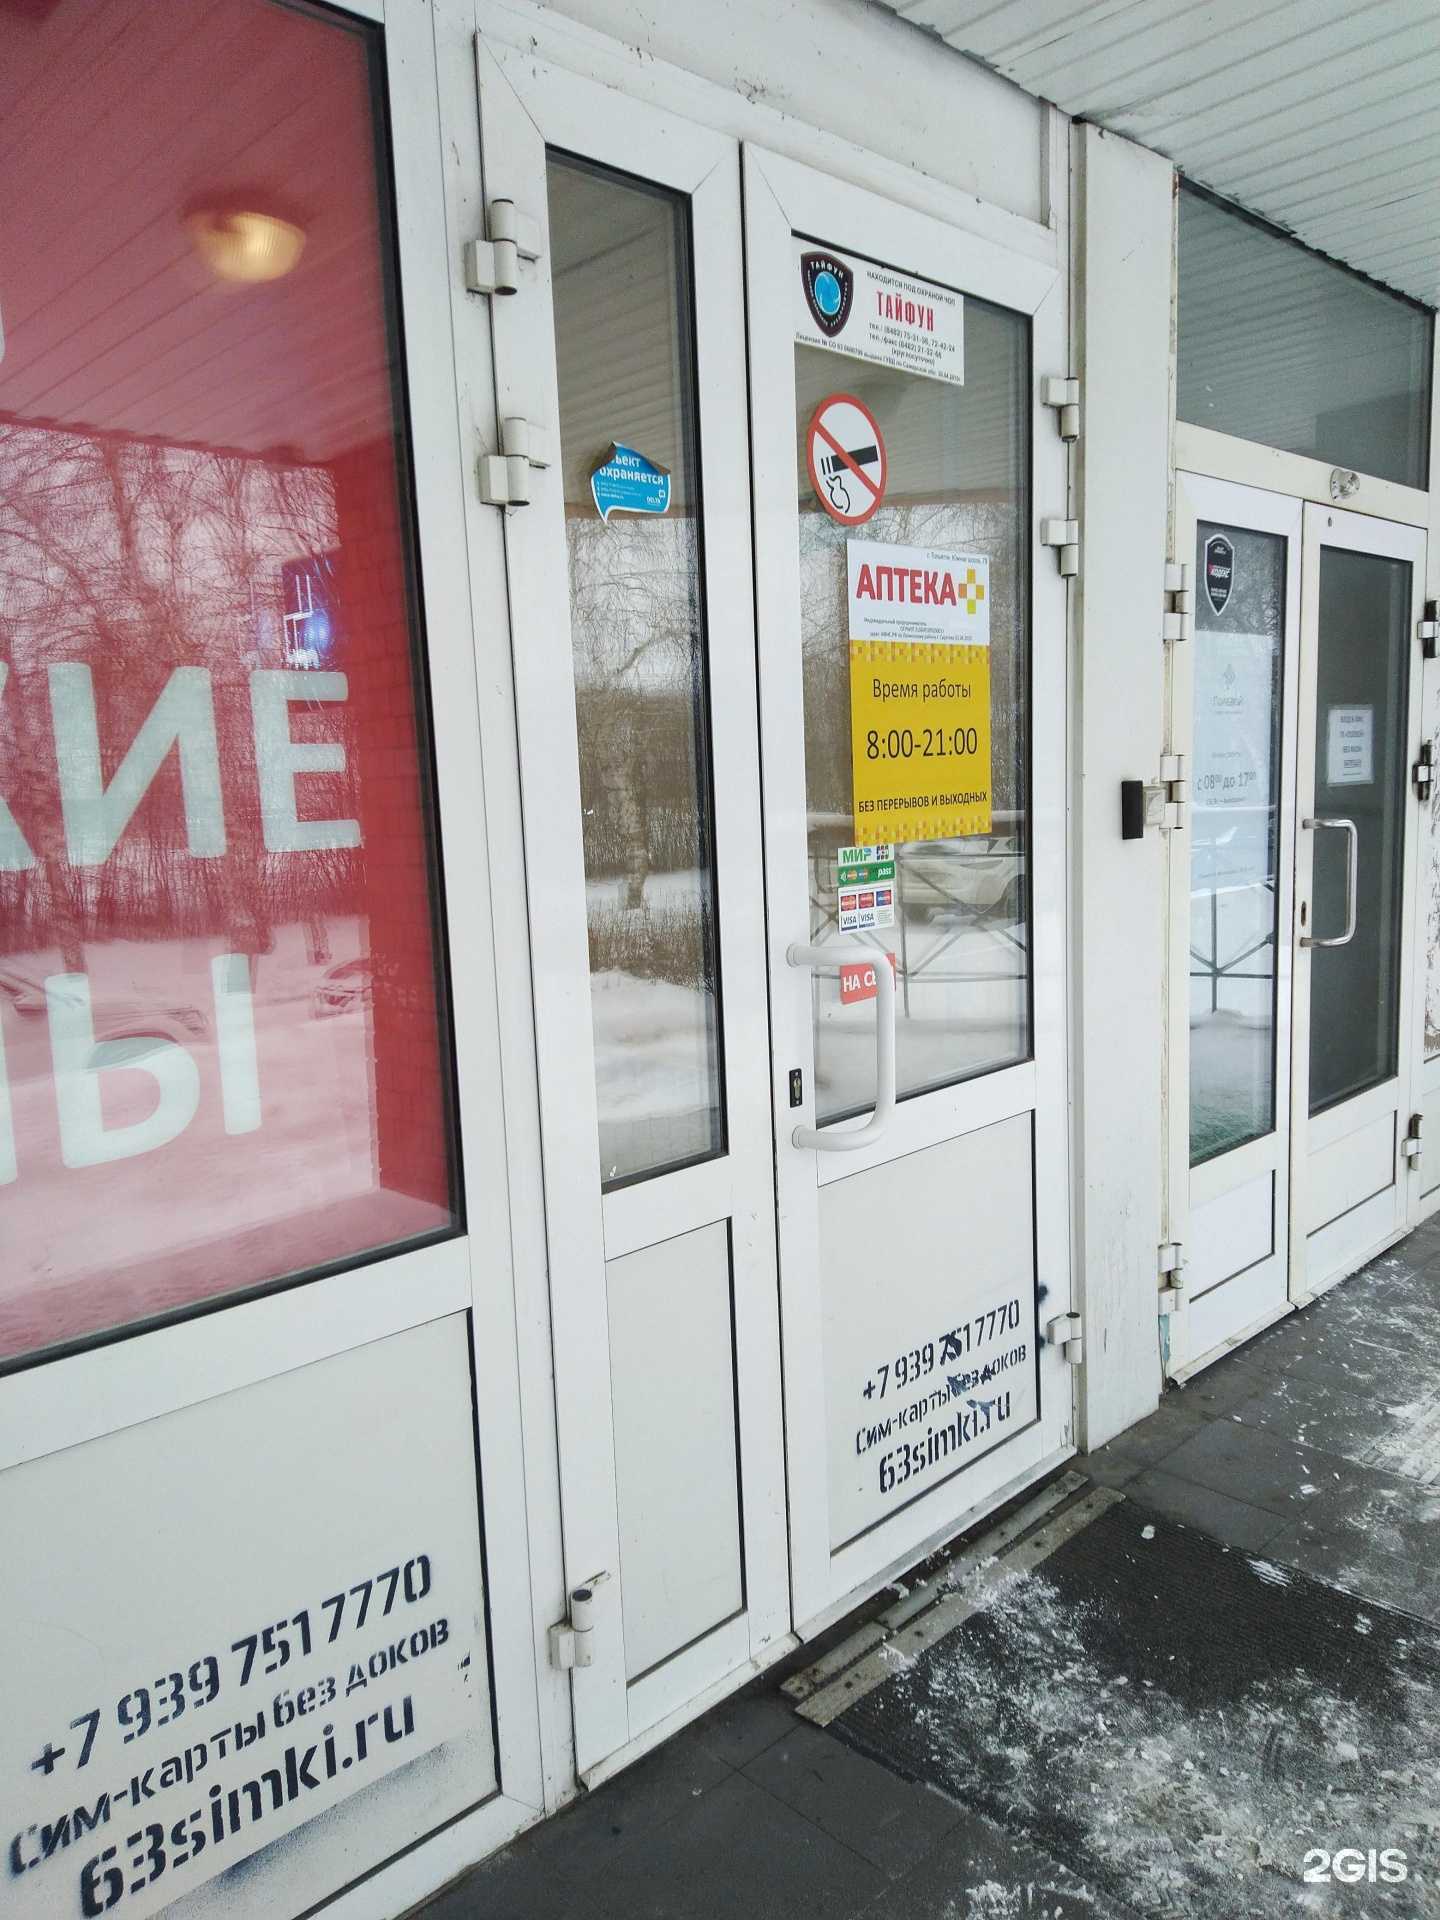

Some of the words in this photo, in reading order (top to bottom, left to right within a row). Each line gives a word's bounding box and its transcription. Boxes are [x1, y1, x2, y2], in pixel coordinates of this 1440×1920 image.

[811, 260, 844, 279] ТАЙФУН
[867, 270, 902, 288] НАХОДИТСЯ
[904, 281, 916, 294] ПОД
[917, 286, 943, 302] ОХРАНОЙ
[876, 291, 935, 332] ТАЙФУН
[599, 466, 664, 486] охраняется
[612, 453, 641, 468] ъект
[856, 564, 957, 606] АПТЕКА
[872, 678, 918, 702] Время
[922, 678, 971, 702] работы
[866, 727, 978, 760] 8:00-21:00
[0, 661, 361, 872] ИЕ
[859, 801, 875, 813] БЕЗ
[877, 795, 930, 812] ПЕРЕРЫВОВ
[931, 795, 938, 806] И
[939, 791, 987, 808] ВЫХОДНЫХ
[843, 848, 872, 864] МИР
[843, 974, 861, 992] НА
[863, 1364, 889, 1400] +7
[895, 1342, 934, 1391] 939
[939, 1322, 971, 1366] 751
[975, 1299, 1020, 1347] 7770
[879, 1391, 1011, 1494] 63simki.ru
[30, 1708, 101, 1776] +7
[117, 1655, 220, 1745] 939
[231, 1609, 312, 1688] 751
[321, 1554, 431, 1645] 7770
[9, 1711, 266, 1876] Сим-карты
[273, 1676, 337, 1728] без
[345, 1618, 450, 1698] доков
[80, 1694, 416, 1920] 63simki.ru
